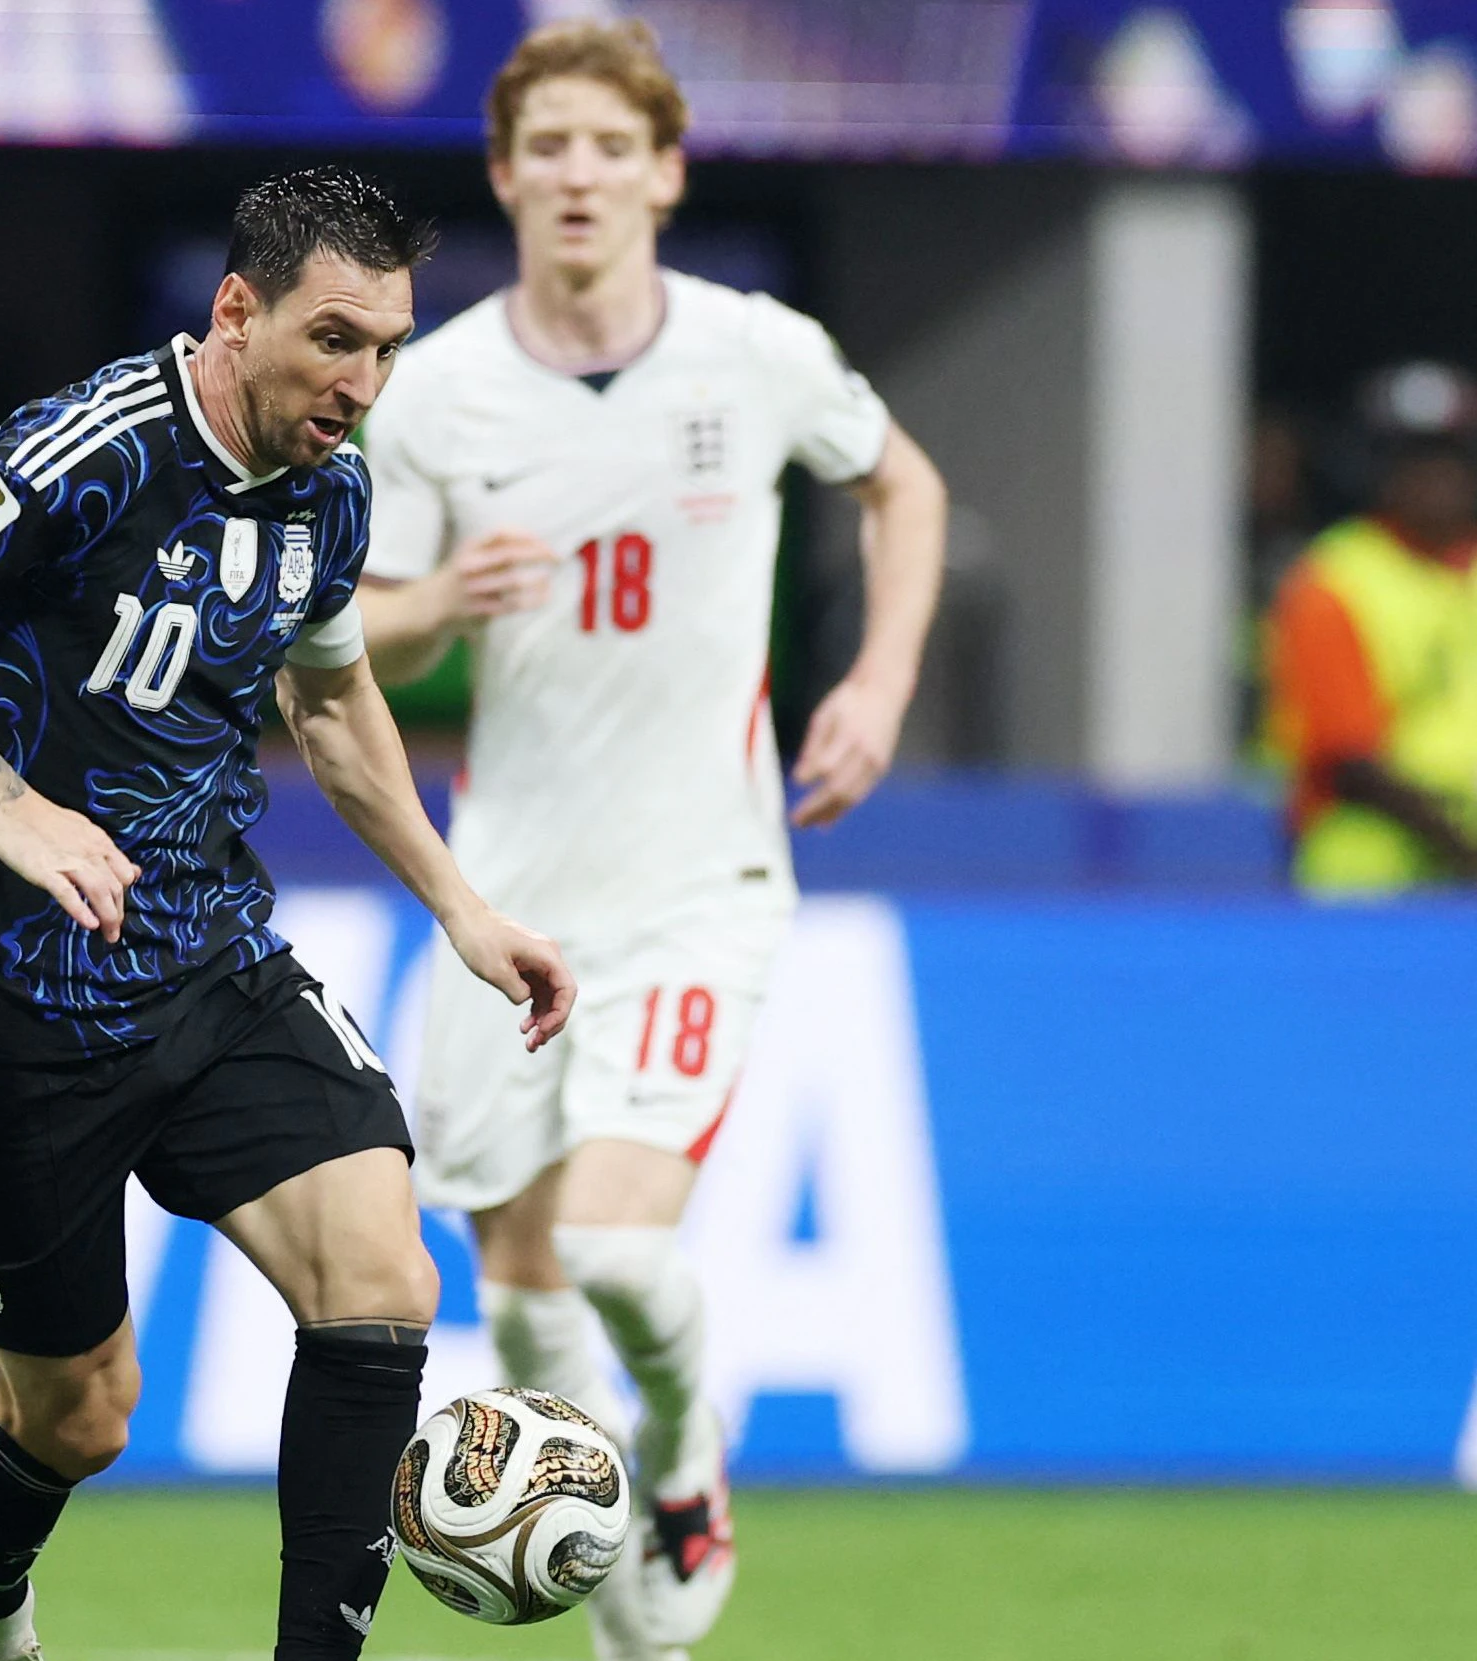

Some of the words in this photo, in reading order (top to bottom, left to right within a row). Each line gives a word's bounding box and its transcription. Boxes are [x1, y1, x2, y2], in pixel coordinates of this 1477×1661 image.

[230, 570, 245, 580] FIFA
[574, 532, 652, 635] 18
[86, 592, 198, 712] 10
[636, 985, 715, 1077] 18
[467, 1451, 489, 1490] NEW
